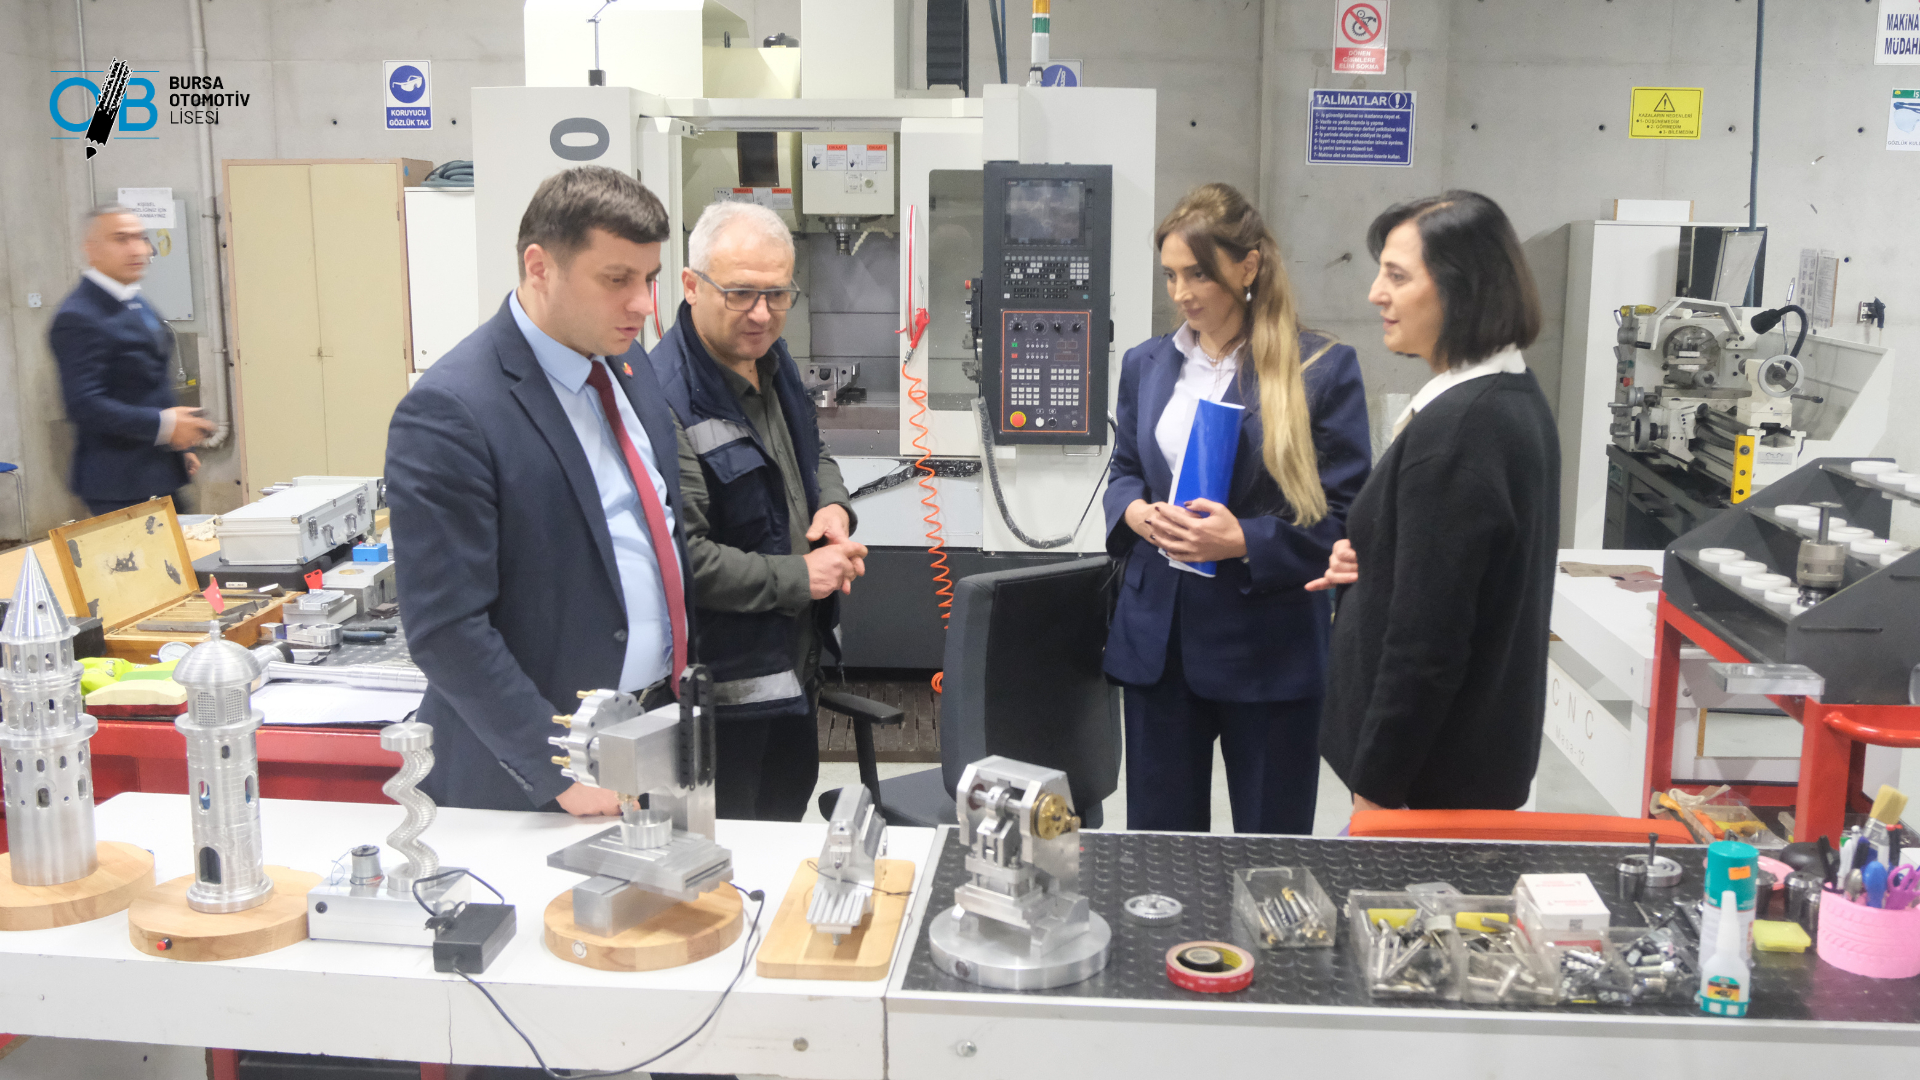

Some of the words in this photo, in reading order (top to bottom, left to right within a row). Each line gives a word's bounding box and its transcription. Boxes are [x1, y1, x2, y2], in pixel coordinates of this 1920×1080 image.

[1885, 37, 1920, 55] MÜDAH
[1317, 93, 1387, 106] TALİMATLAR
[389, 118, 415, 126] GÖZLÜK
